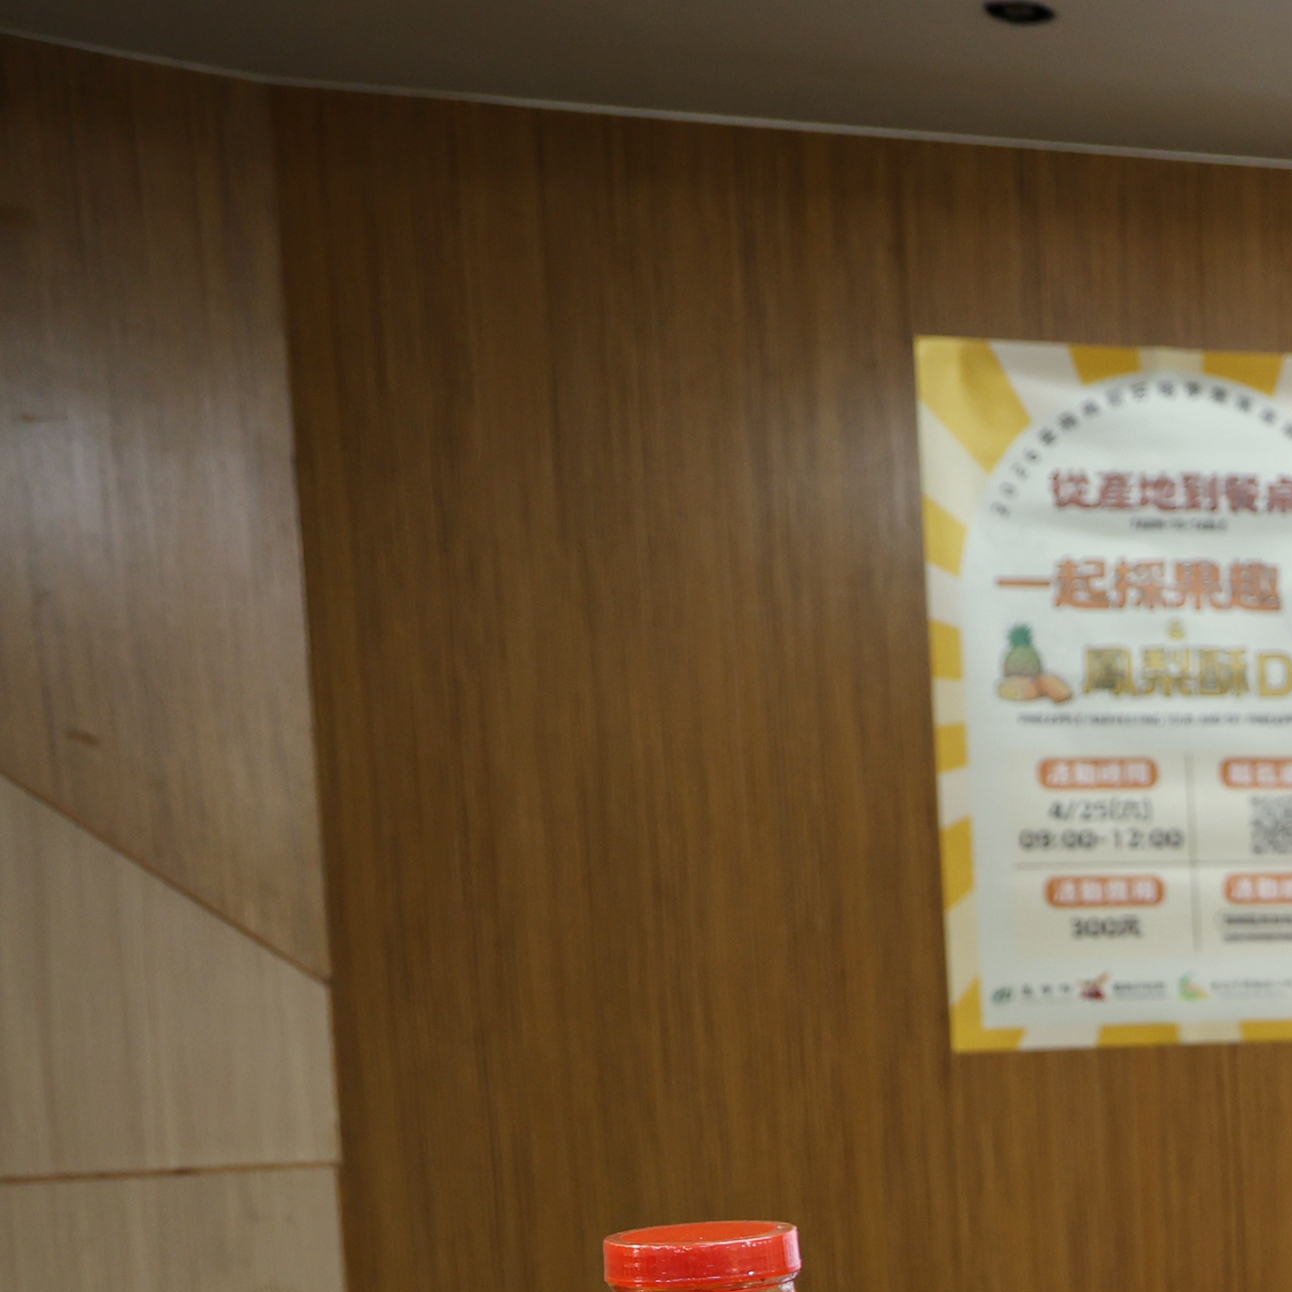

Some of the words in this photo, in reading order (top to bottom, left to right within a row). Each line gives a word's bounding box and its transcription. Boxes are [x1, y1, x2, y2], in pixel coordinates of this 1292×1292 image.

[995, 558, 1281, 610] 一起採果趣
